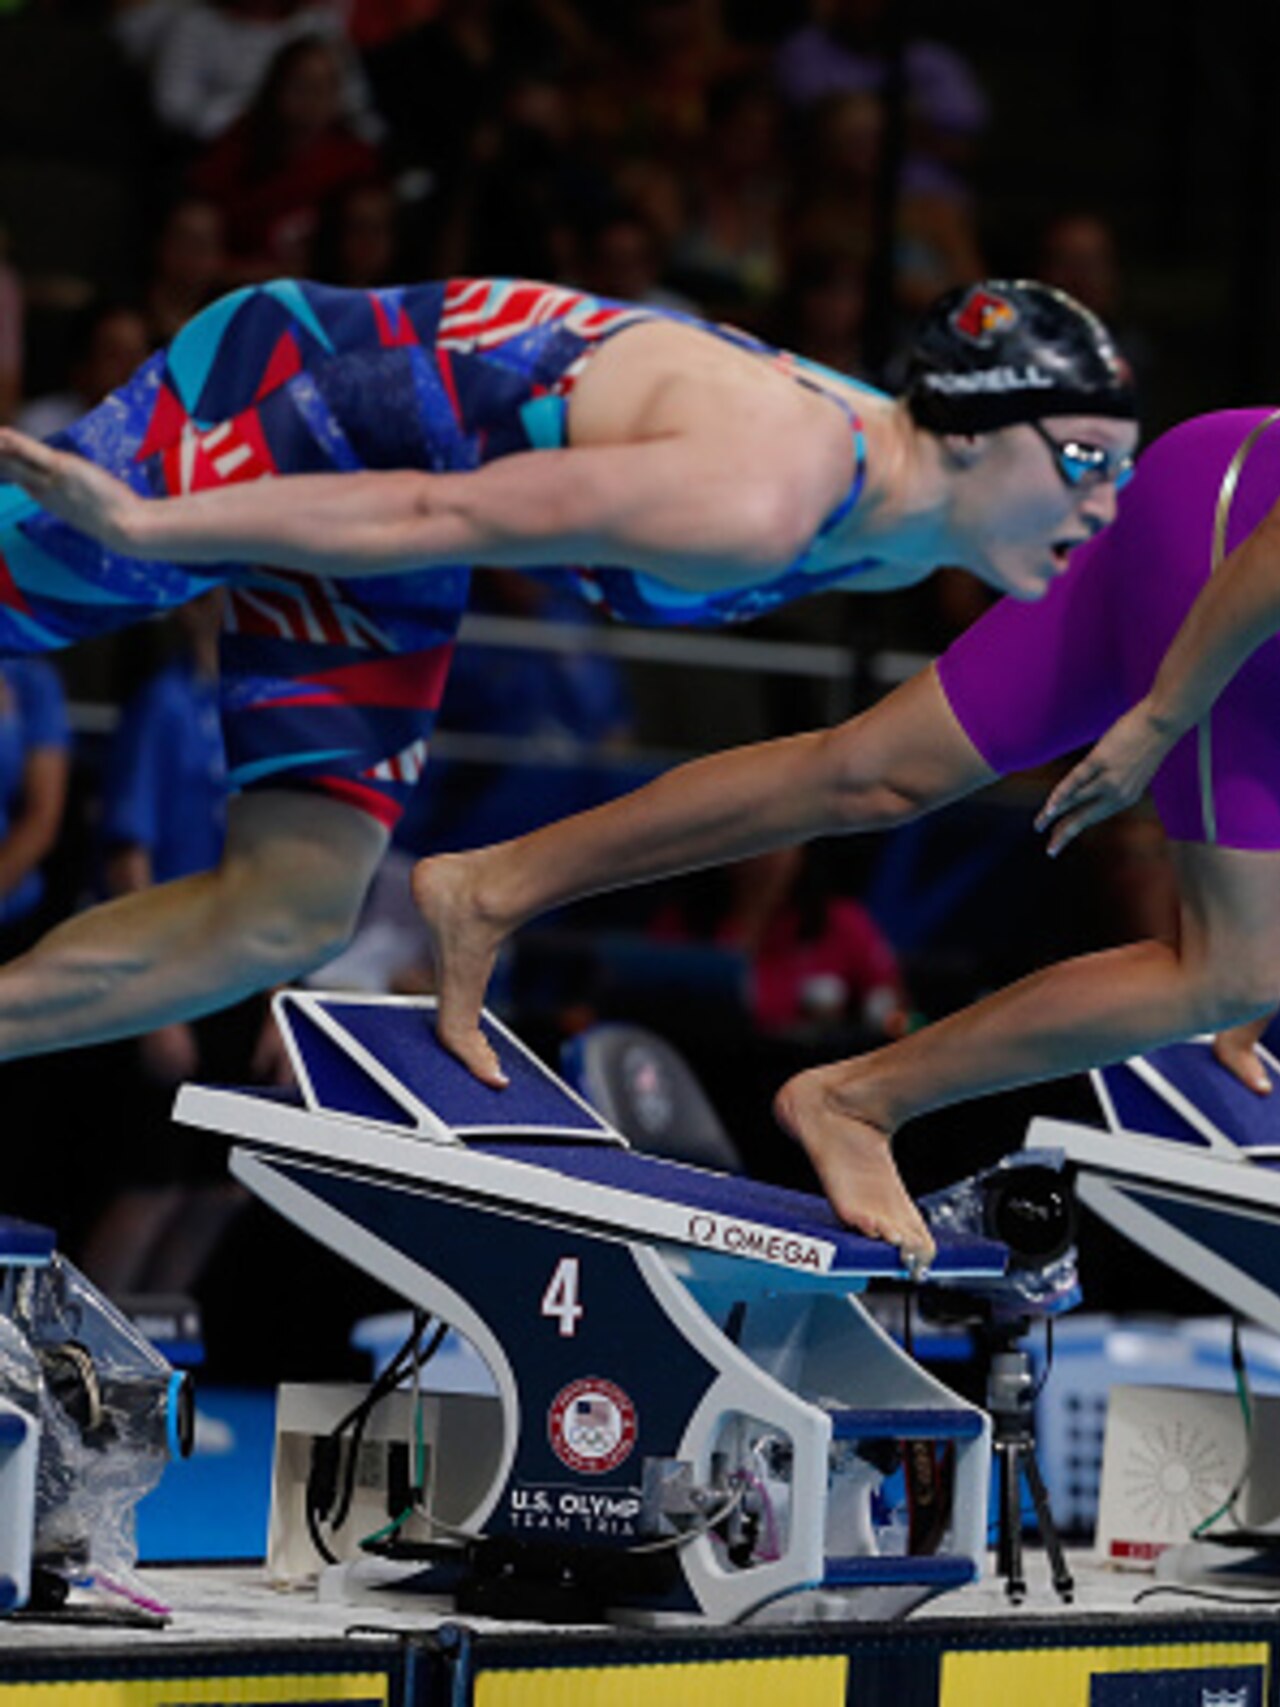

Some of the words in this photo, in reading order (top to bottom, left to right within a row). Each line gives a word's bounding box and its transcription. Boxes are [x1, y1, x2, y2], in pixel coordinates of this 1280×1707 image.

[723, 1224, 820, 1269] OMEGA
[541, 1257, 583, 1338] 4
[511, 1490, 553, 1514] U.S.
[510, 1512, 571, 1531] TEAM
